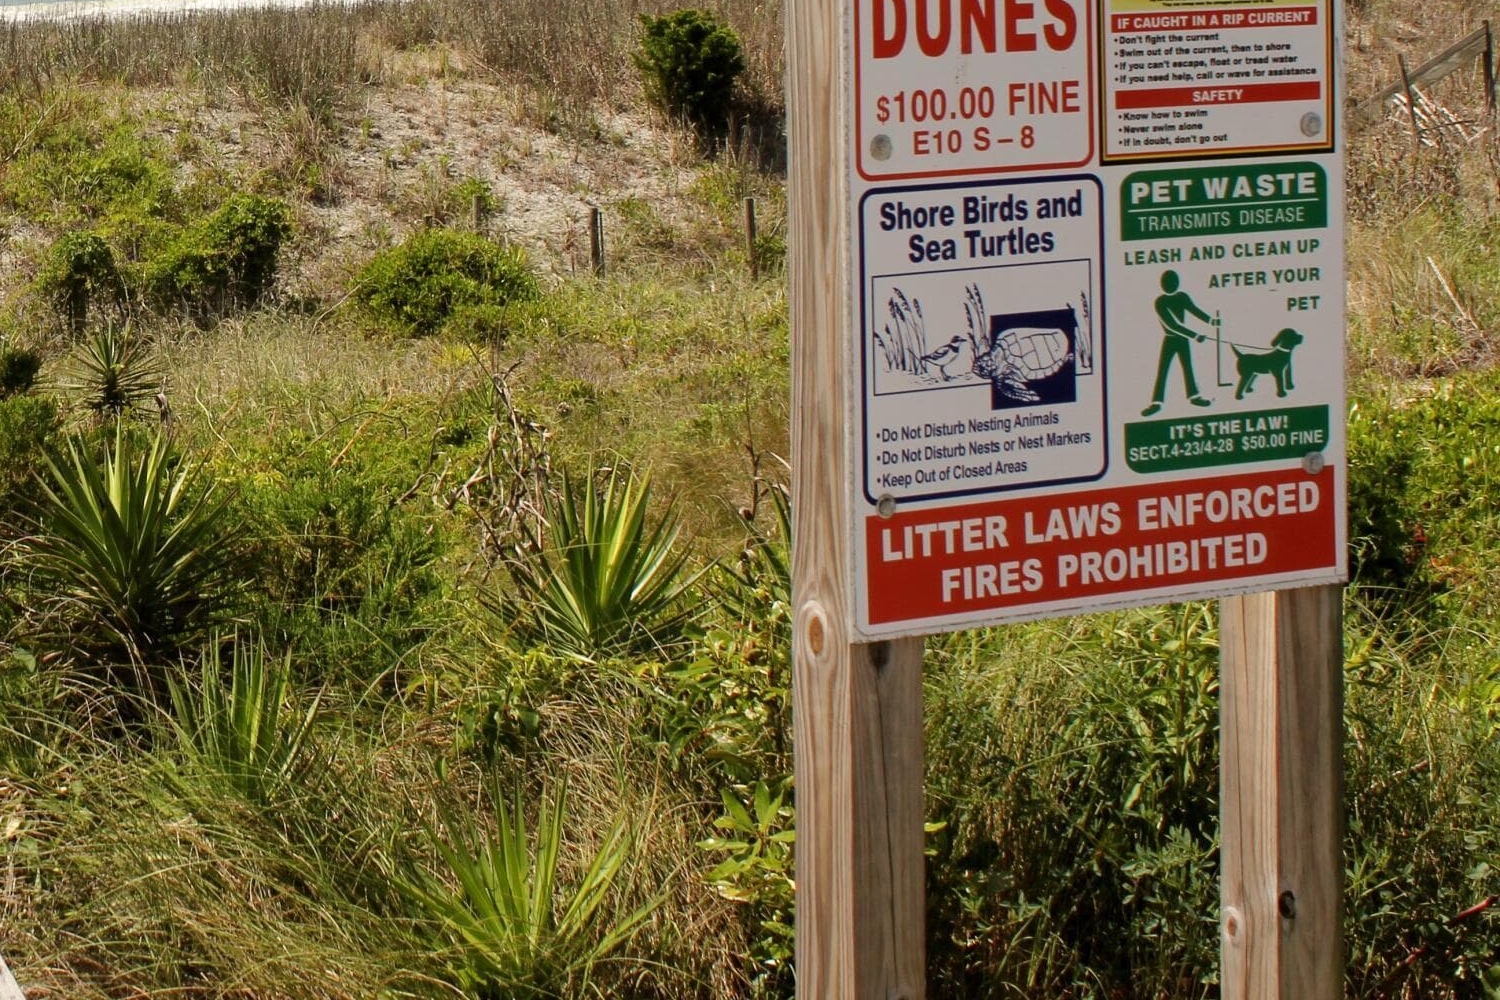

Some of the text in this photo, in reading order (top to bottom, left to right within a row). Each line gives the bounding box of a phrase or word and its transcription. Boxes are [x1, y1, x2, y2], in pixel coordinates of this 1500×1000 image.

[1117, 11, 1310, 29] IF CAUGHT IN A RIP CURRENT
[1120, 36, 1142, 44] Don't
[1145, 35, 1165, 44] fight
[1169, 34, 1183, 42] the
[1120, 49, 1143, 57] Swim
[1193, 46, 1228, 54] current,
[1120, 62, 1126, 70] If
[1129, 63, 1144, 71] you
[1172, 60, 1207, 69] escape,
[1210, 58, 1230, 66] float
[1120, 75, 1126, 83] If
[1129, 75, 1144, 84] you
[1148, 74, 1169, 82] need
[1172, 72, 1194, 80] help,
[1196, 71, 1212, 79] call
[1268, 68, 1316, 76] assistance
[876, 80, 1080, 123] $100.00 FINE
[1192, 89, 1243, 102] SAFETY
[1151, 111, 1170, 119] how
[1173, 110, 1182, 118] to
[1185, 109, 1208, 117] swim
[1124, 123, 1203, 133] Never swim alone
[914, 129, 962, 156] E10
[1144, 137, 1171, 145] doubt,
[1175, 135, 1197, 143] don't
[1199, 136, 1210, 144] go
[1131, 172, 1316, 204] PET WASTE
[880, 189, 1082, 231] Shore Birds and
[1138, 207, 1305, 232] TRANSMITS DISEASE
[908, 226, 1054, 263] Sea Turtles
[1124, 239, 1320, 265] LEASH AND CLEAN UP
[1209, 268, 1320, 288] AFTER YOUR
[1287, 296, 1320, 311] PET
[882, 411, 1059, 442] Do Not Disturb Nesting Animals
[1170, 416, 1288, 439] IT'S THE LAW!
[882, 431, 1091, 465] Do Not Disturb Nests or Nest Markers
[1241, 433, 1286, 450] $50.00
[1291, 430, 1324, 445] FINE
[883, 459, 1027, 488] Keep Out of Closed Areas
[881, 480, 1320, 562] LITTER LAWS ENFORCED
[942, 532, 1268, 602] FIRES PROHIBITED
